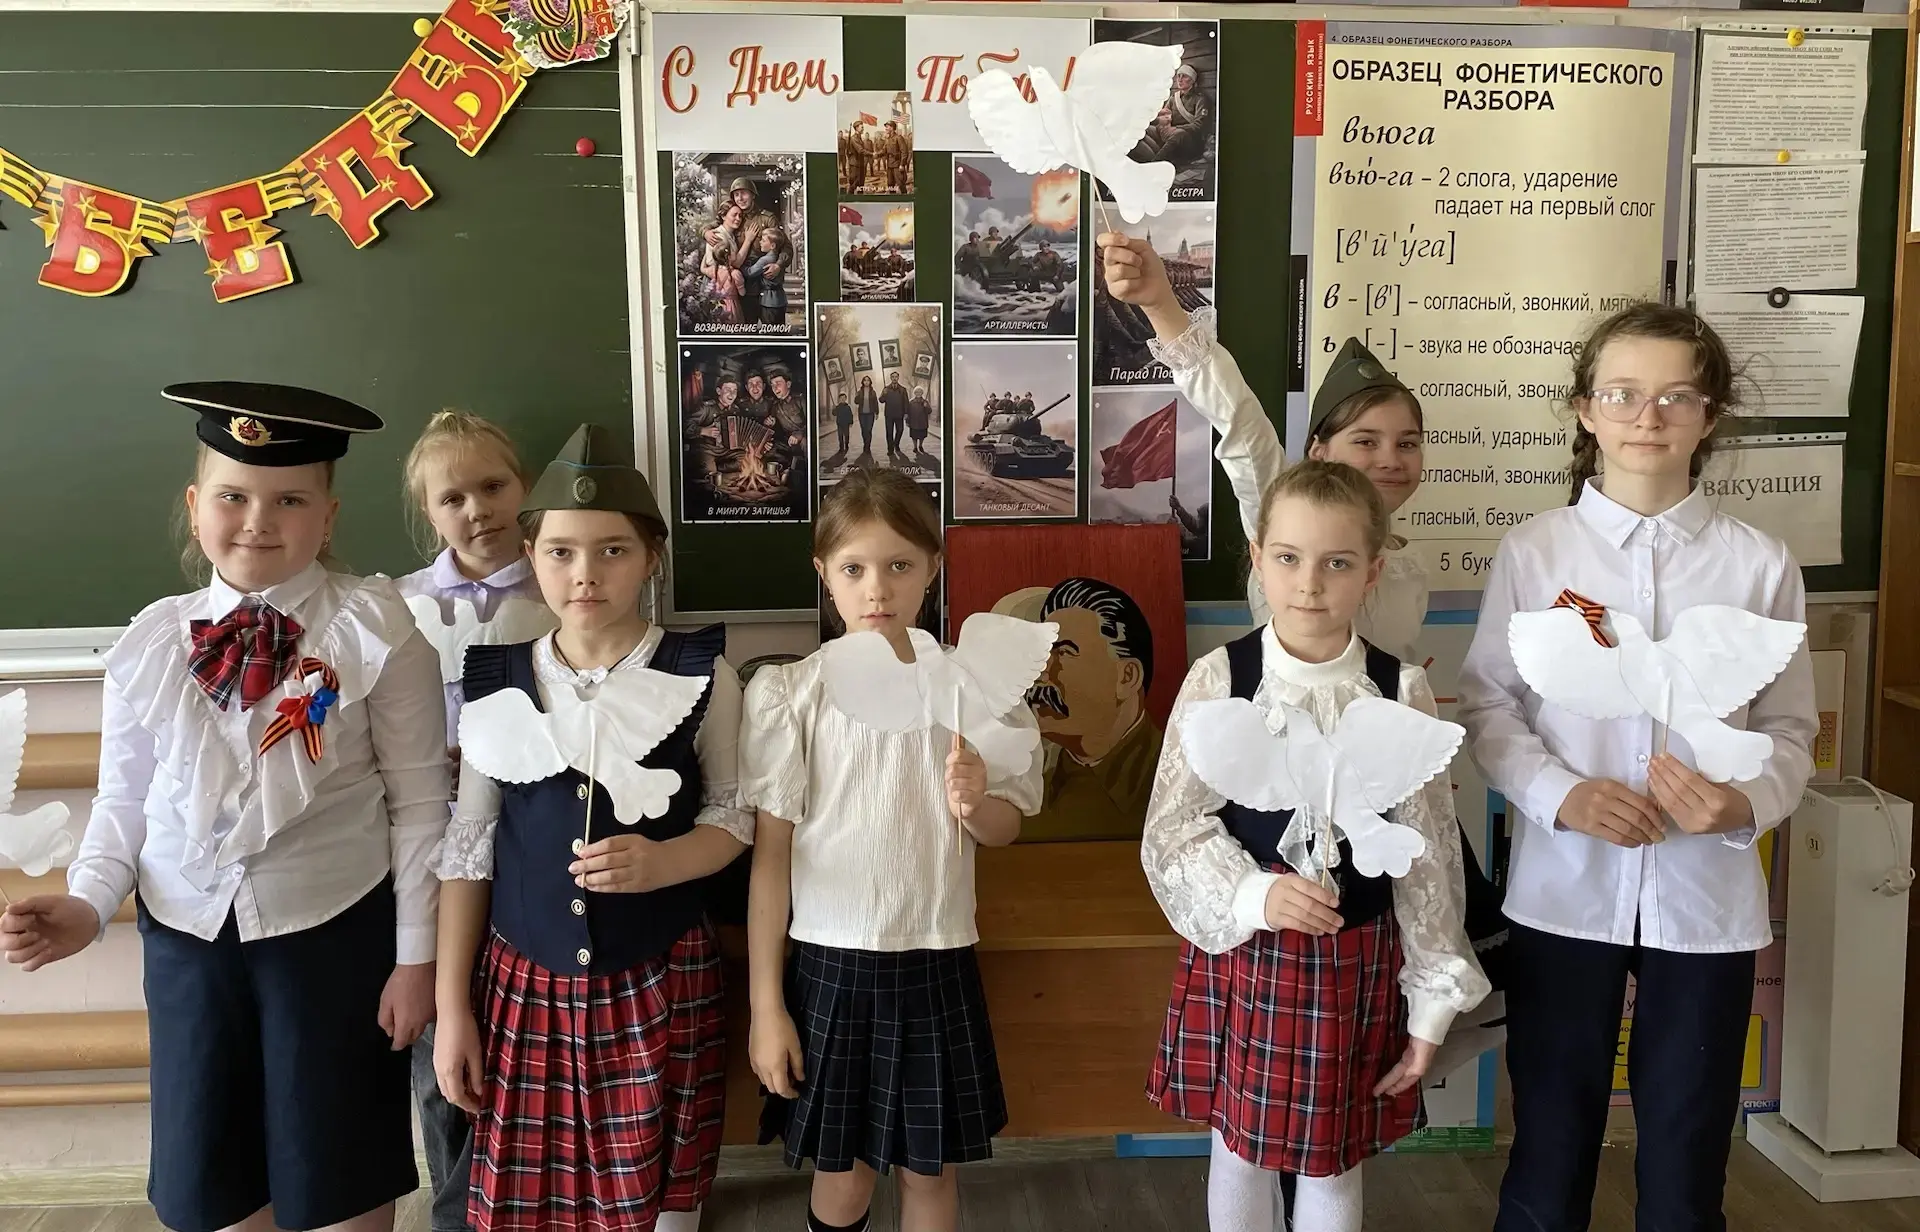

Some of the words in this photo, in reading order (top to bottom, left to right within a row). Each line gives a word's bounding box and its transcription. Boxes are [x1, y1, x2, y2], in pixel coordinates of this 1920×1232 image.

[1342, 36, 1384, 45] ОБРАЗЕЦ
[1387, 37, 1467, 46] ФОНЕТИЧЕСКОГО
[1470, 39, 1512, 47] РАЗБОРА
[1307, 39, 1315, 66] ЯЗЫК
[662, 45, 697, 113] С
[727, 45, 839, 108] Днем
[1332, 59, 1442, 86] ОБРАЗЕЦ
[1456, 62, 1663, 87] ФОНЕТИЧЕСКОГО
[1305, 71, 1314, 115] РУССКИЙ
[1443, 90, 1555, 110] РАЗБОРА
[1343, 116, 1436, 146] вьюга
[1438, 166, 1450, 187] 2
[1456, 171, 1516, 190] слога,
[1523, 171, 1618, 193] ударение
[1172, 187, 1204, 198] СЕСТРА
[1435, 199, 1503, 218] падает
[1510, 199, 1533, 215] на
[1540, 196, 1614, 219] первый
[1620, 200, 1656, 217] слог
[1323, 283, 1341, 309] в
[1424, 292, 1516, 314] согласный,
[1522, 292, 1594, 314] звонкий,
[694, 322, 757, 334] ВОЗВРАЩЕНИЕ
[759, 321, 791, 334] ДОМОЙ
[985, 320, 1048, 330] АРТИЛЛЕРИСТЫ
[1419, 337, 1461, 358] звука
[1468, 338, 1488, 354] не
[1493, 335, 1587, 355] обозначае
[1110, 367, 1150, 382] Парад
[1420, 380, 1512, 400] согласный,
[1421, 426, 1485, 447] ласный,
[1491, 428, 1567, 450] ударный
[1420, 465, 1499, 486] огласный,
[1701, 474, 1823, 501] вакуация
[707, 507, 714, 515] В
[716, 507, 750, 516] МИНУТУ
[752, 507, 790, 516] ЗАТИШЬЯ
[979, 501, 1020, 512] ТАНКОВЫЙ
[1020, 503, 1050, 512] ДЕСАНТ
[1411, 507, 1479, 527] гласный,
[1440, 552, 1450, 572] 5
[1462, 552, 1493, 576] бук
[1810, 837, 1819, 851] 31
[1754, 976, 1782, 986] ное
